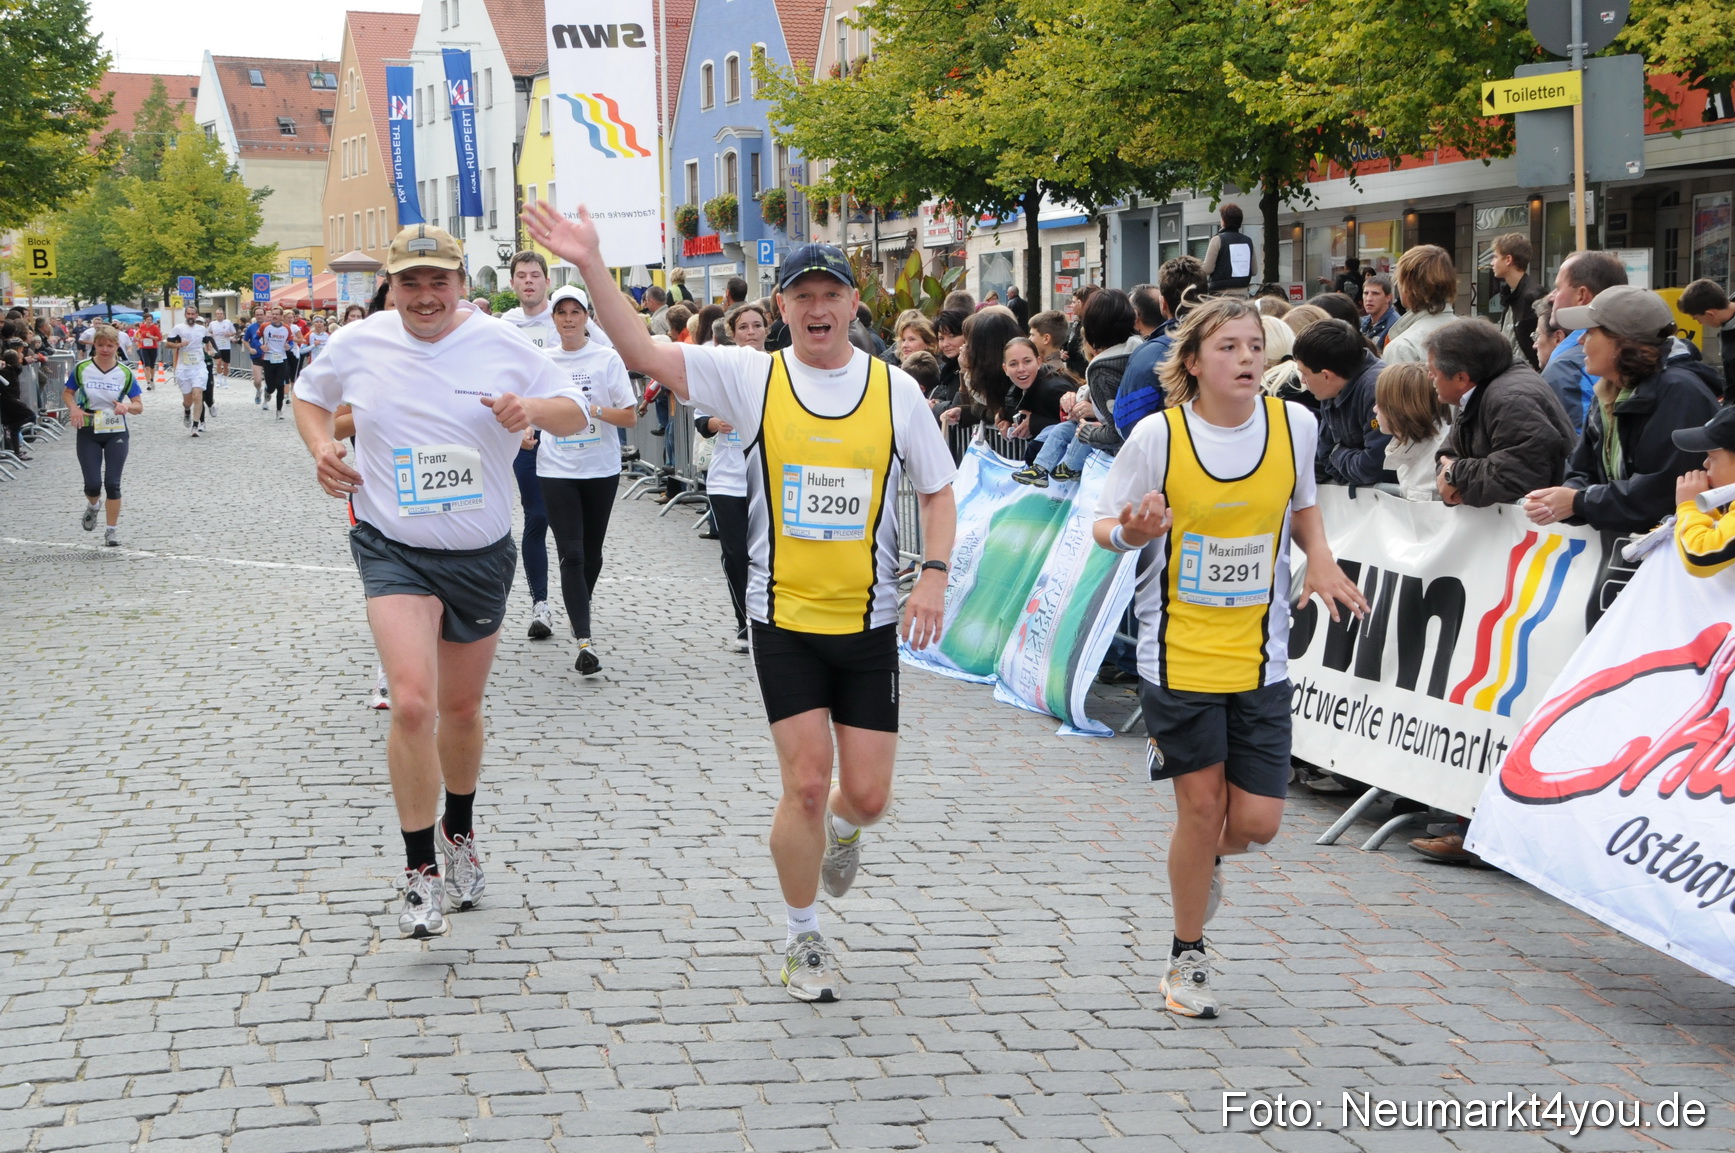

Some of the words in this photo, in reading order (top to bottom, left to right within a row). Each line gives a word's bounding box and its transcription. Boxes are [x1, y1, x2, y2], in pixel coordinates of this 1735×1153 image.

[1503, 85, 1565, 103] Toiletten
[462, 111, 475, 169] RUPPERT
[27, 237, 51, 246] Block
[33, 249, 49, 269] B
[255, 292, 270, 300] TAXI
[86, 381, 121, 392] BOCK
[105, 417, 120, 425] 864
[417, 452, 448, 465] Franz
[421, 468, 474, 491] 2294
[807, 472, 845, 488] Hubert
[787, 490, 794, 501] D
[807, 494, 860, 515] 3290
[1208, 542, 1265, 558] Maximilian
[1186, 558, 1193, 569] D
[1207, 561, 1260, 583] 3291
[1388, 711, 1508, 776] neumarkt
[1606, 816, 1735, 912] Ostbay
